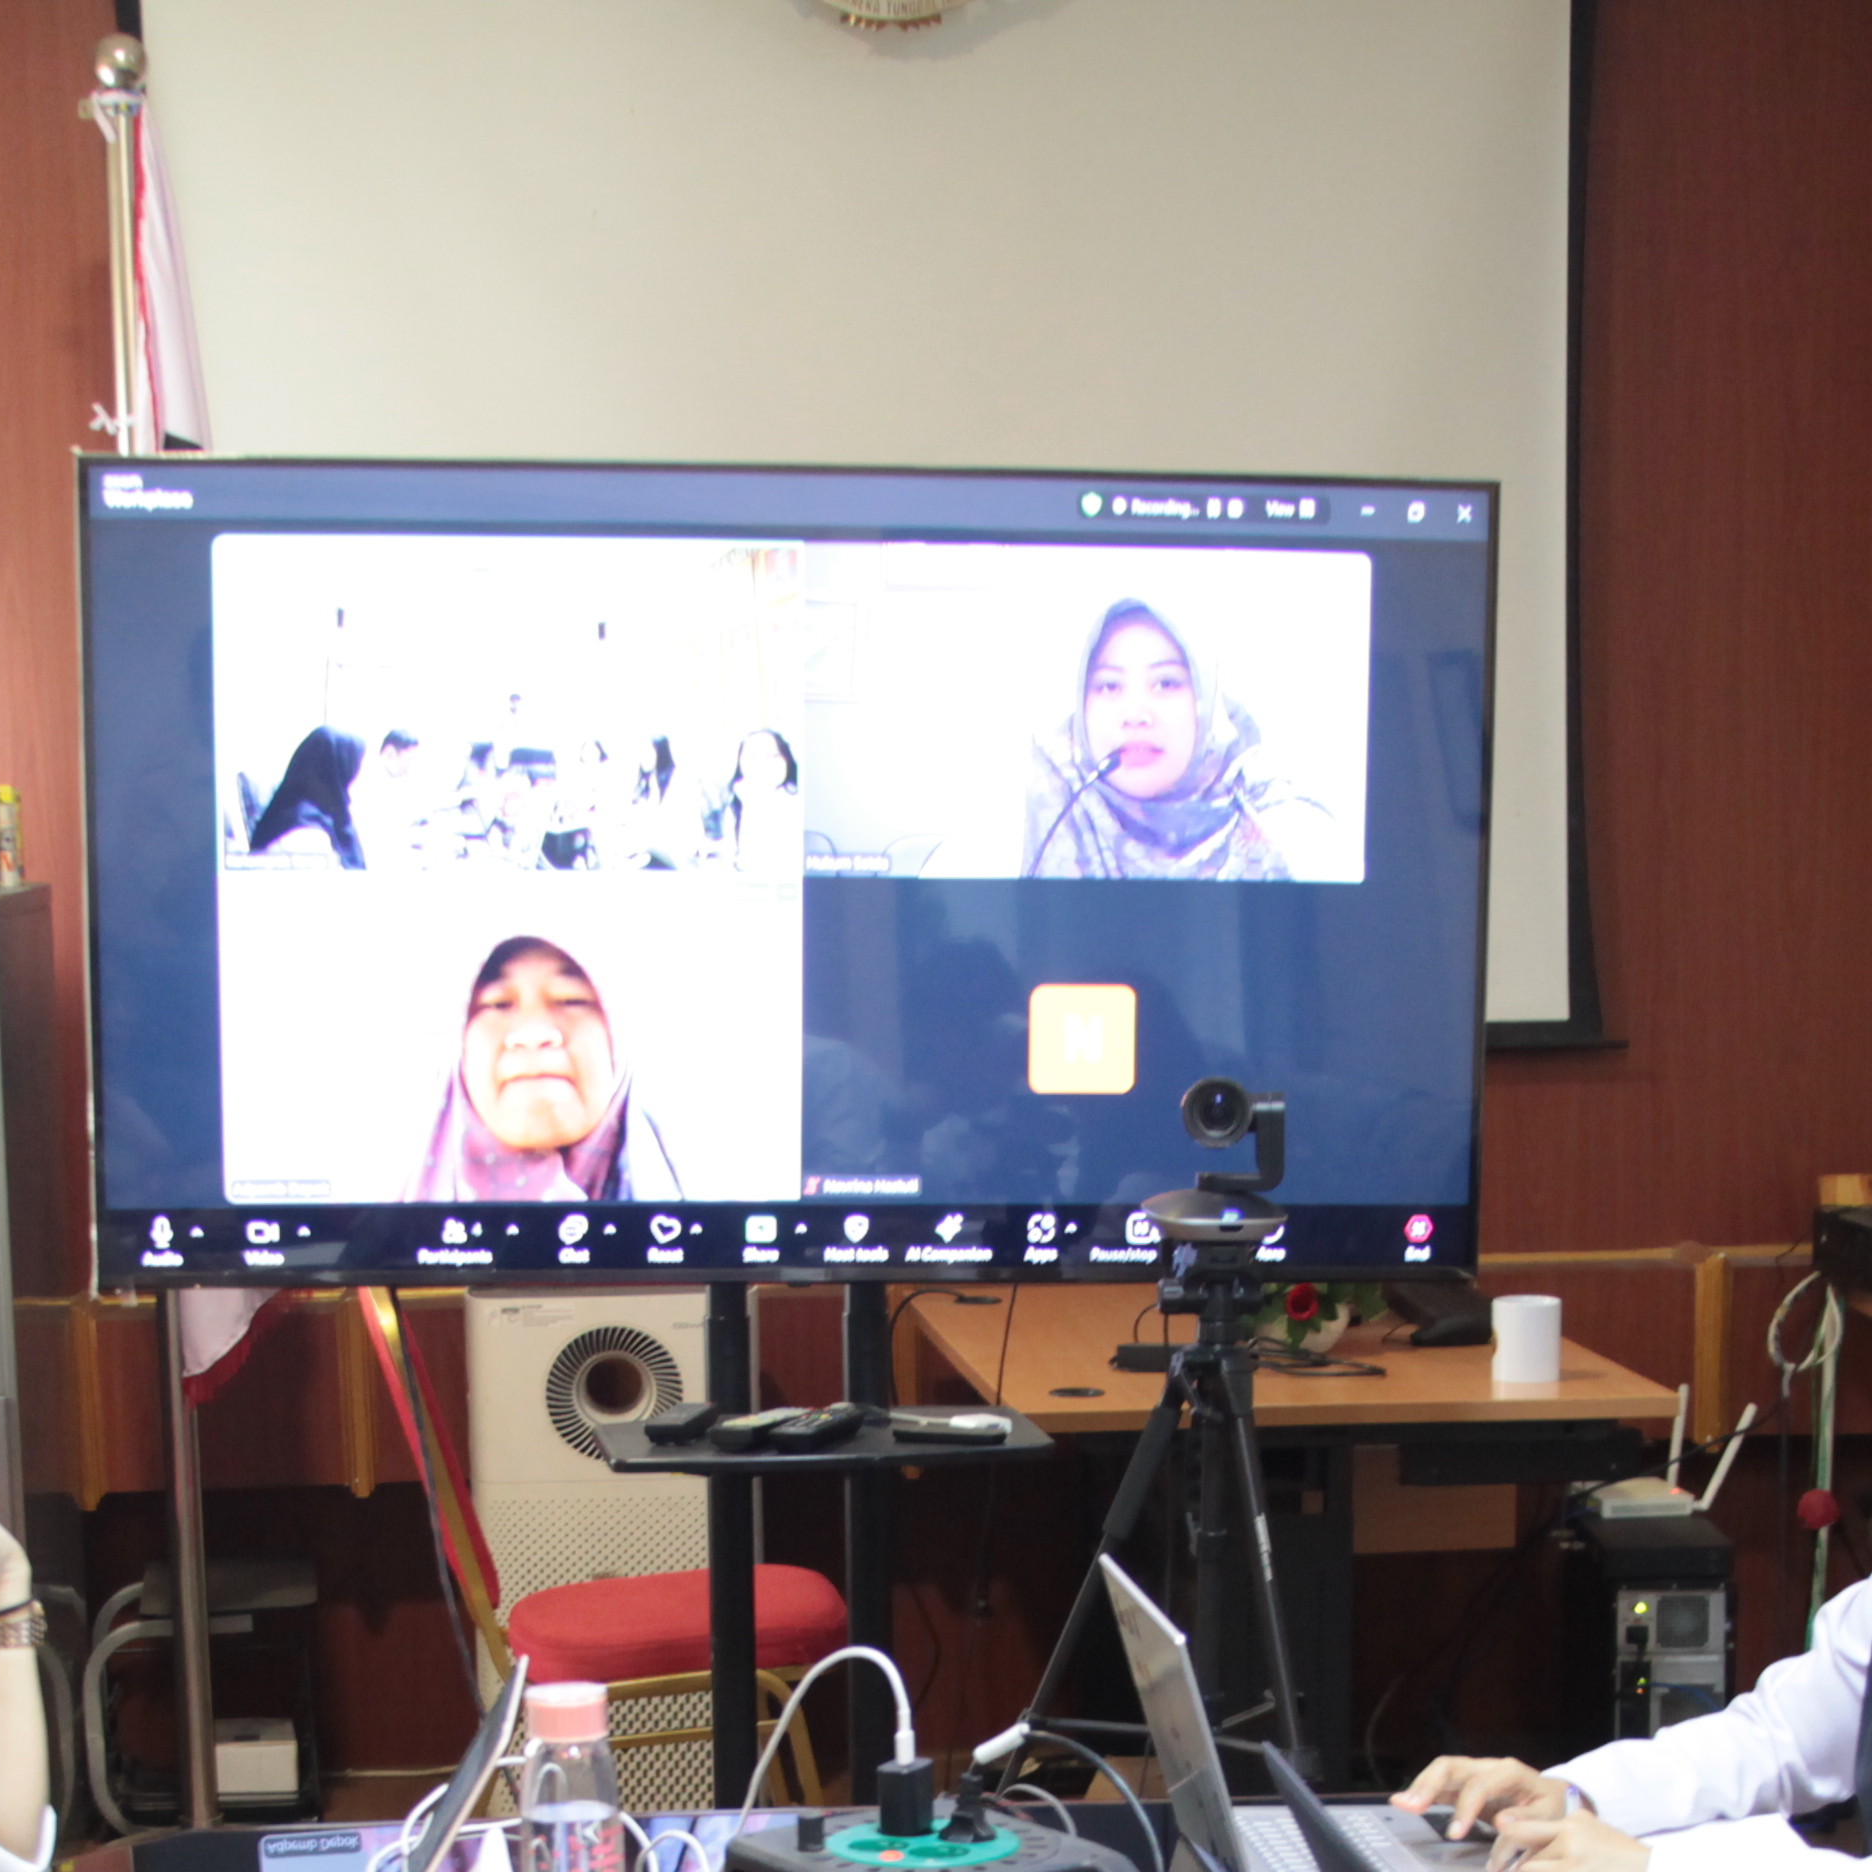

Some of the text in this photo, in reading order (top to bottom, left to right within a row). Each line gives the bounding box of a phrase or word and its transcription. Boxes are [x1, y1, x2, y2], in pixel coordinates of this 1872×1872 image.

[102, 489, 194, 511] Workplace
[1265, 499, 1296, 518] View
[1064, 1013, 1104, 1064] N
[142, 1249, 184, 1266] Audio
[243, 1249, 285, 1266] Video
[417, 1247, 493, 1267] Participants
[558, 1246, 590, 1263] Chat
[647, 1246, 684, 1263] React
[742, 1246, 780, 1263] Share
[823, 1245, 889, 1262] Host tools
[905, 1246, 993, 1264] AI Companion
[1024, 1246, 1058, 1265] Apps
[1089, 1246, 1158, 1265] Pause/stop
[1404, 1245, 1432, 1262] End
